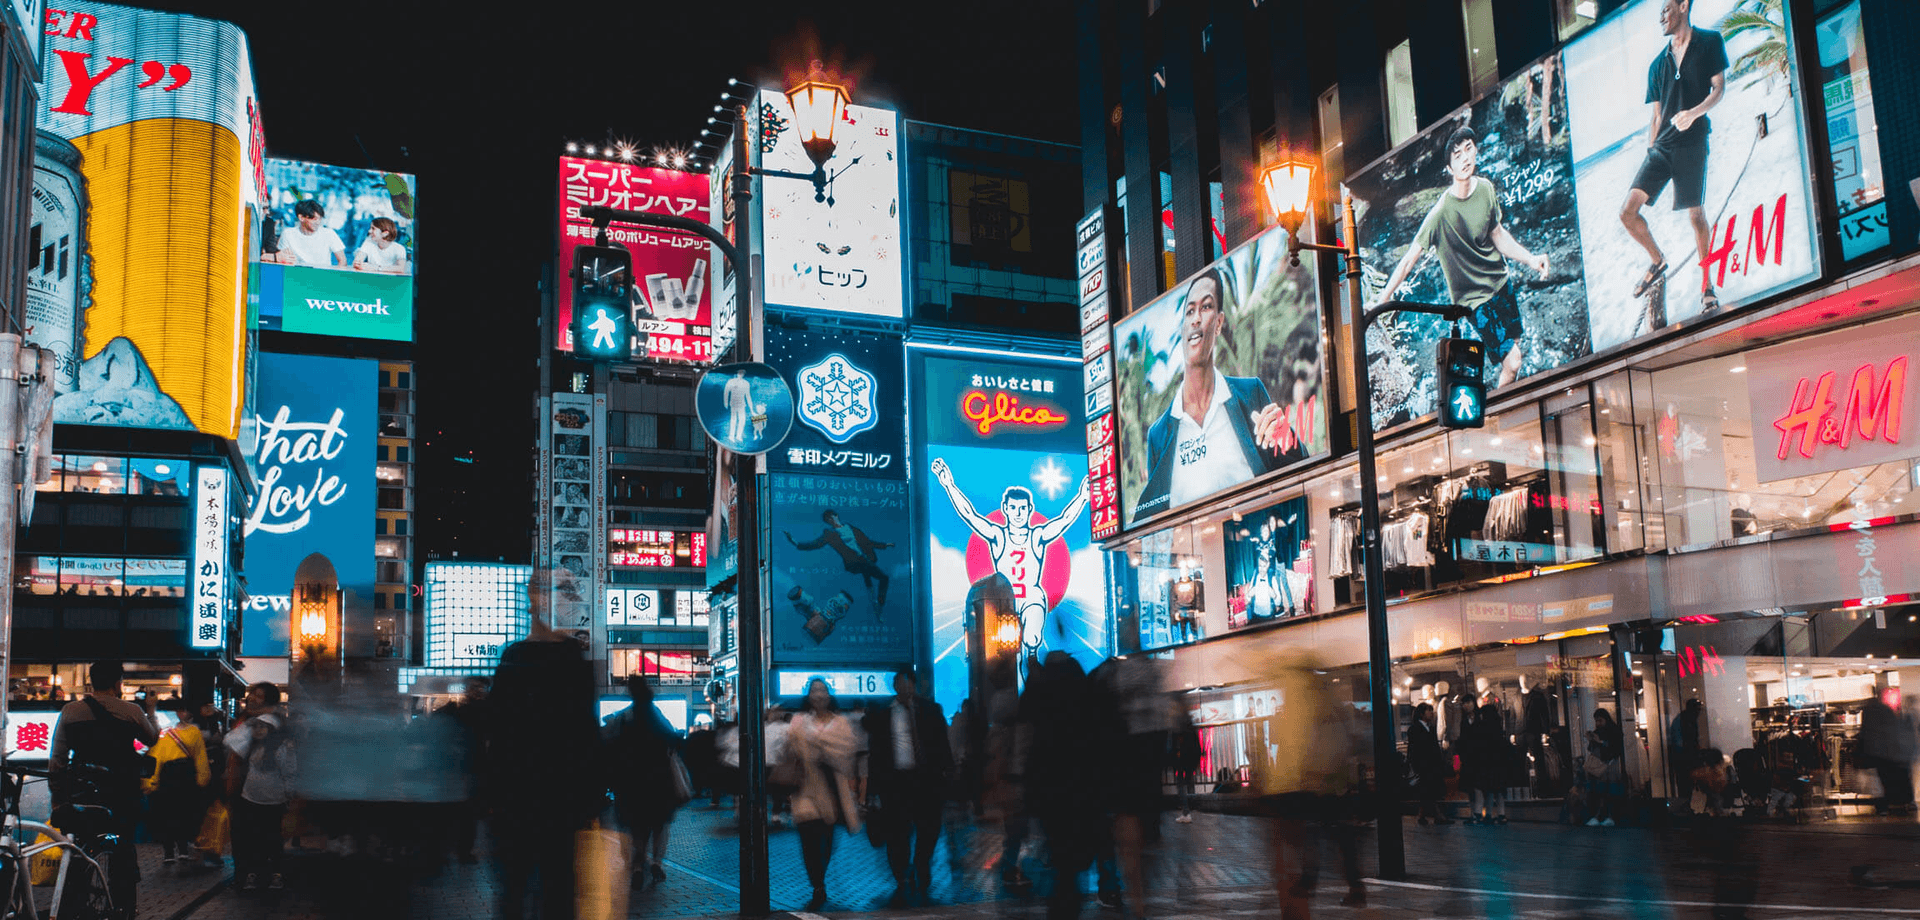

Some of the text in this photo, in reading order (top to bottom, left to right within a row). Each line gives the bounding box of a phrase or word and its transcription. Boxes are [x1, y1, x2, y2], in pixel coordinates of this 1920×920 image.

[45, 8, 97, 41] ER
[567, 163, 652, 189] スーパー
[1502, 157, 1542, 188] Tシャツ
[1504, 168, 1555, 206] ¥1,299
[567, 184, 710, 216] ミリオンヘアー
[1699, 193, 1788, 292] H&M
[305, 297, 391, 317] wework
[641, 323, 669, 332] ルアン
[971, 373, 1054, 394] おいしさと健康
[963, 389, 1066, 433] Glico
[1773, 354, 1909, 461] H&M
[787, 447, 892, 469] 雪印メグミルク
[1102, 413, 1118, 522] インターネット
[1180, 445, 1207, 466] ¥1,299
[1091, 466, 1104, 527] コミック
[1009, 549, 1027, 599] グリコ
[856, 675, 876, 693] 16
